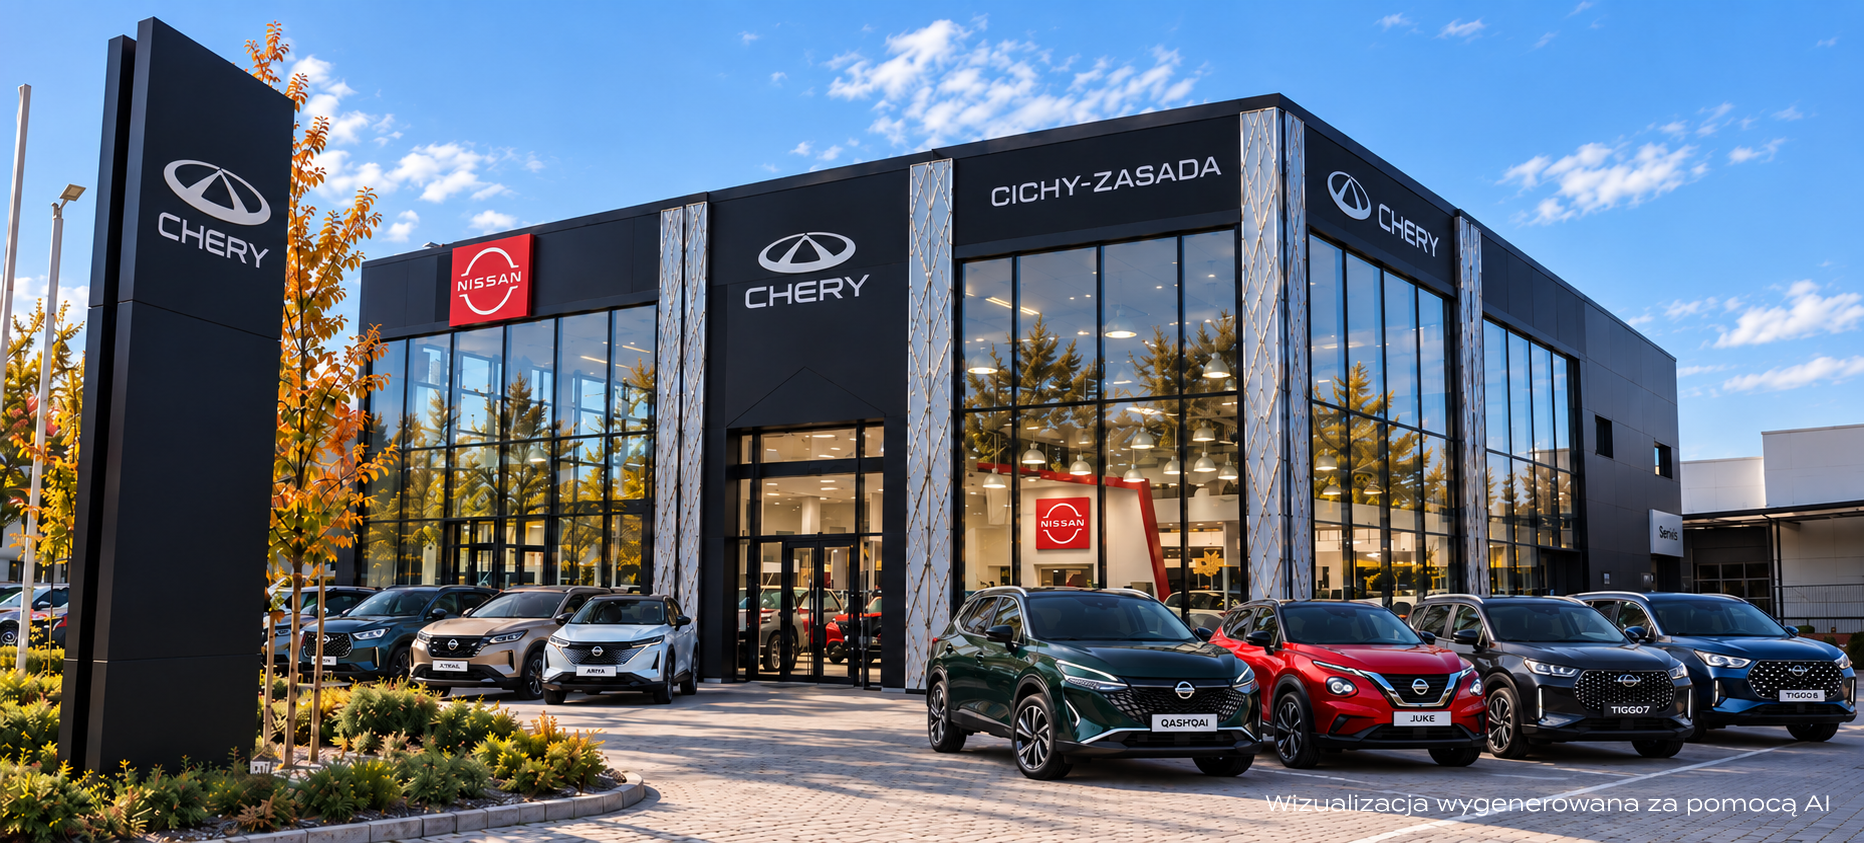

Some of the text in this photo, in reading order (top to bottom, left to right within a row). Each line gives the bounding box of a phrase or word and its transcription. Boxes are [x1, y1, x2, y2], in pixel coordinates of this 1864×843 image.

[991, 156, 1222, 207] CICHY-ZASADA
[158, 211, 269, 269] CHERY
[1378, 203, 1439, 257] CHERY
[457, 270, 522, 292] NISSAN
[745, 274, 870, 309] CHERY
[1040, 519, 1085, 528] NISSAN
[1160, 718, 1209, 729] QASHQAI
[1410, 714, 1435, 723] JUKE
